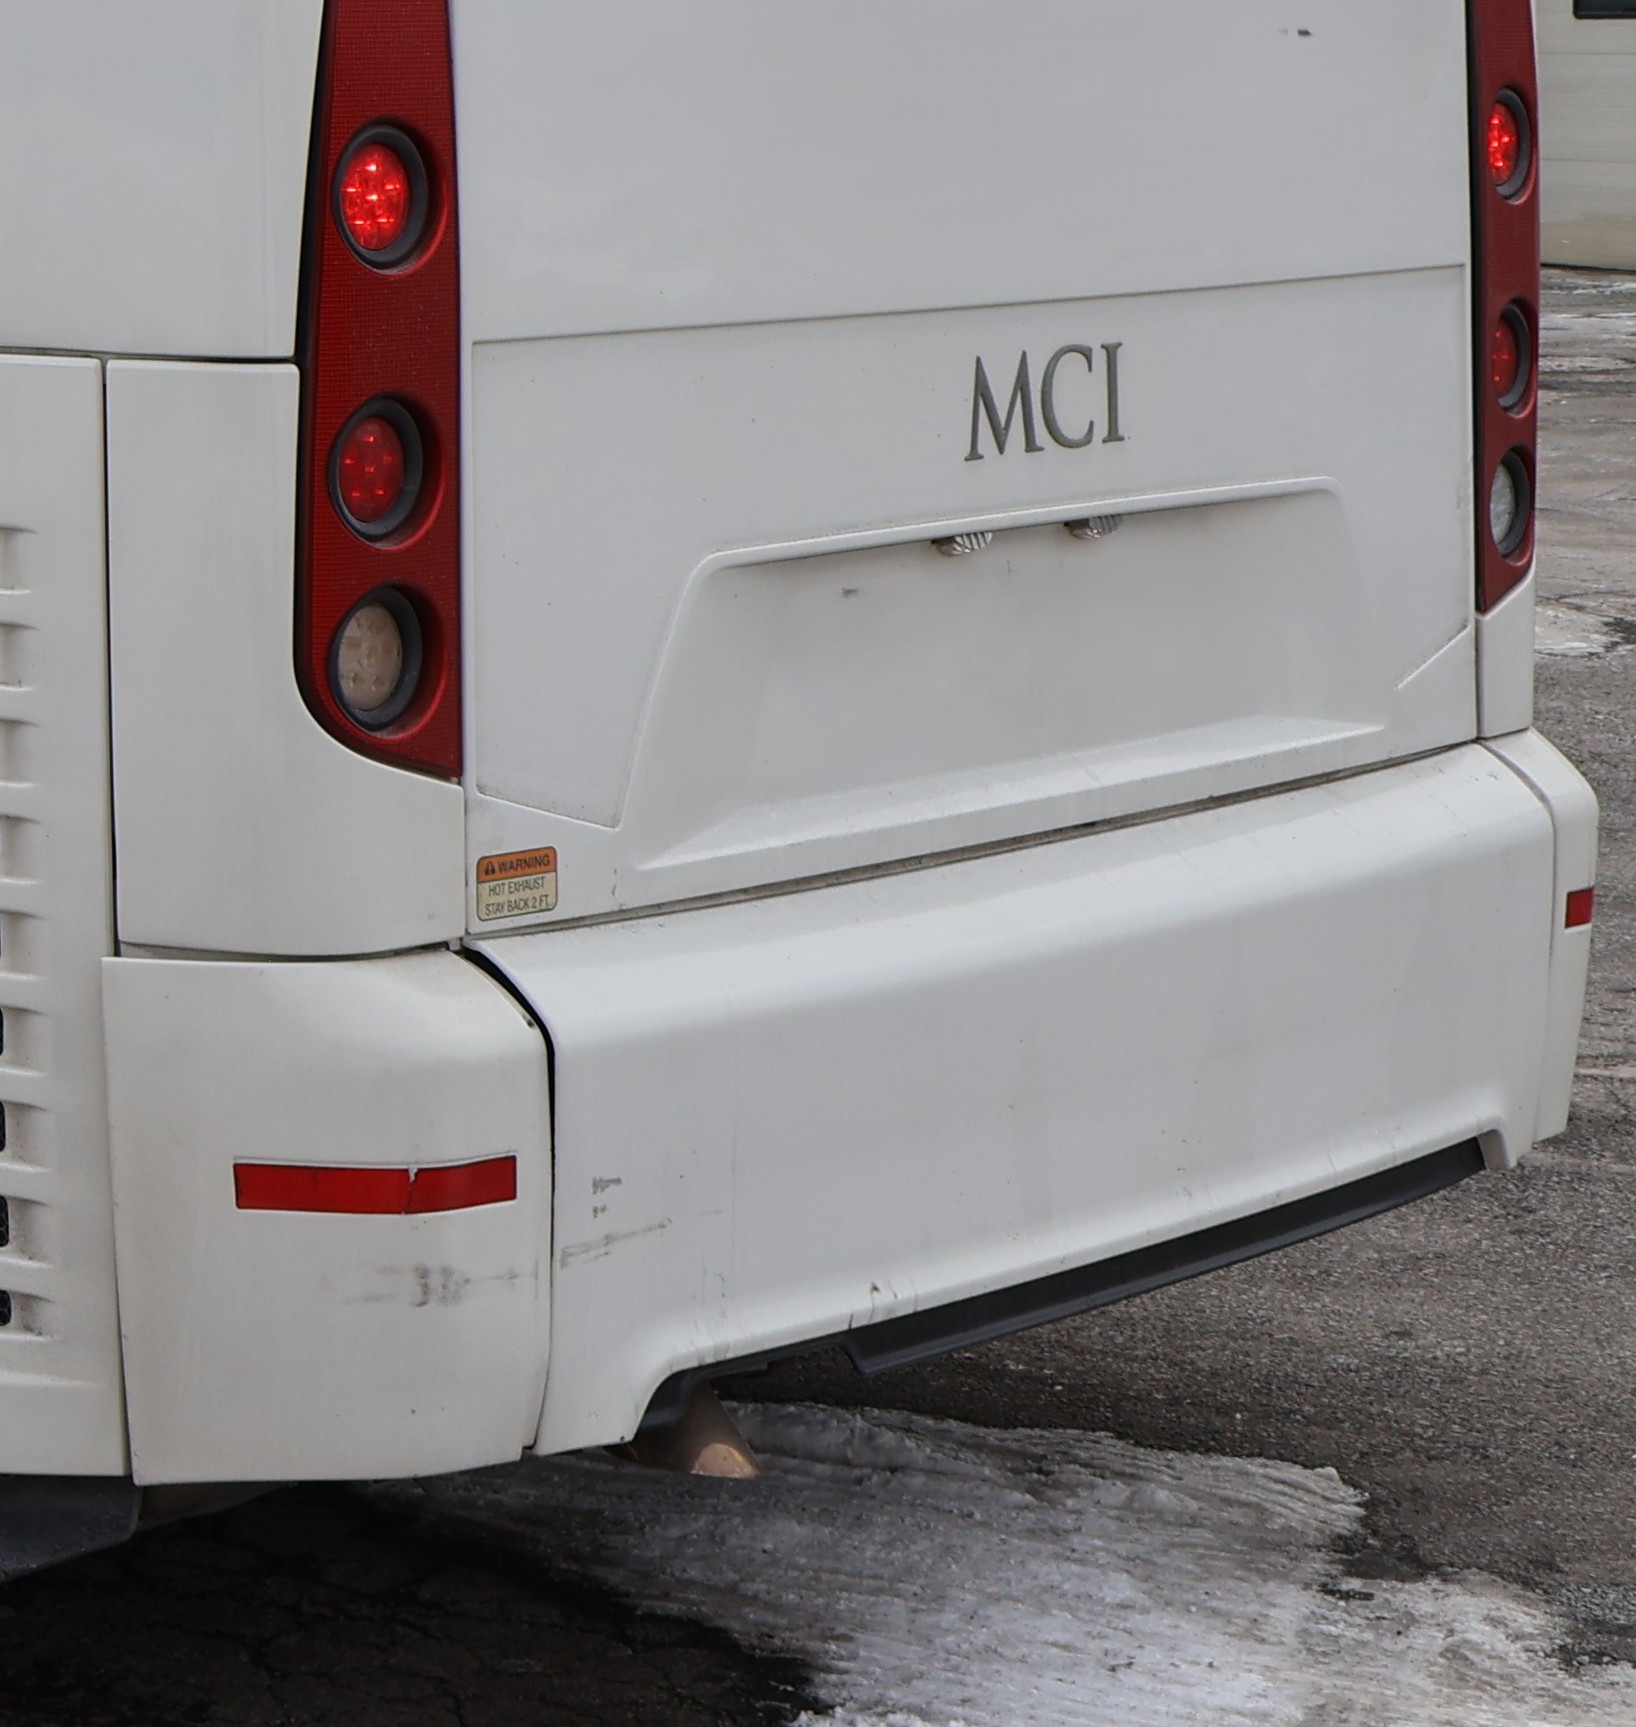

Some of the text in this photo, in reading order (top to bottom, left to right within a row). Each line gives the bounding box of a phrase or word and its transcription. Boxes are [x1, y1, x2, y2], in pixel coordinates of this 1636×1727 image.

[964, 342, 1125, 462] MCI
[498, 854, 551, 874] WARNING
[488, 876, 546, 897] HOT EXHAUST
[484, 894, 549, 917] STAY BACK 2 FT
